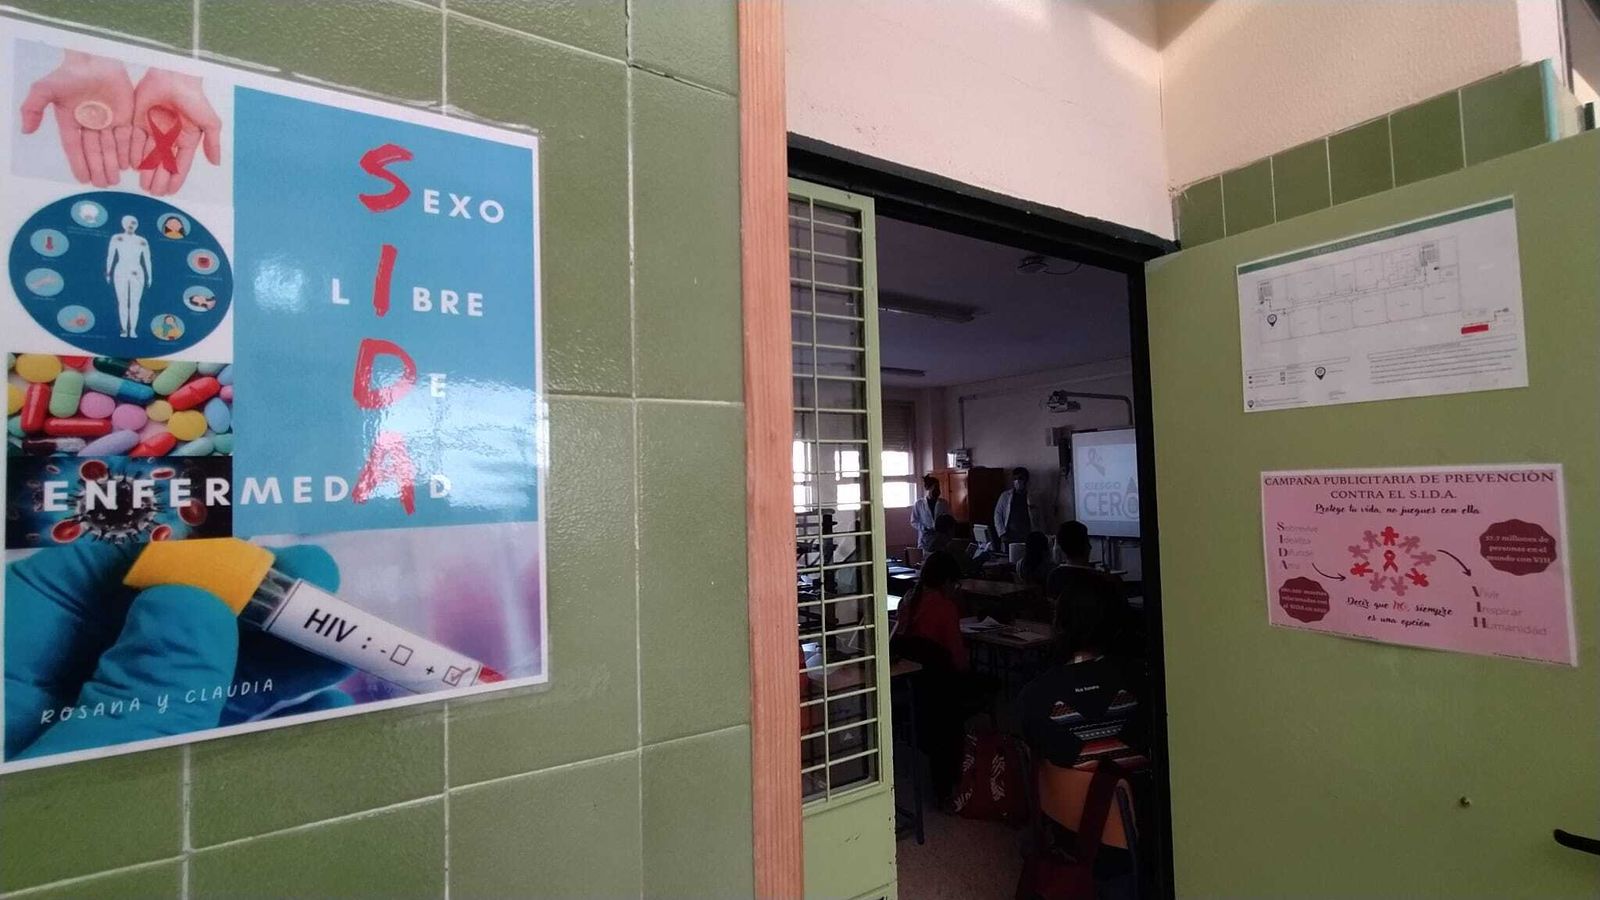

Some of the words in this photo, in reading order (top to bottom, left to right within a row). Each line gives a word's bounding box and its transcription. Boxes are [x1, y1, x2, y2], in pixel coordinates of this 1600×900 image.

[358, 143, 505, 225] SEXO
[331, 244, 484, 318] LIBRE
[353, 337, 447, 410] DE
[43, 431, 452, 516] ENFERMEDAD
[1264, 475, 1320, 486] CAMPAÑA
[1323, 474, 1415, 485] PUBLICITARIA
[1420, 474, 1440, 484] DE
[1445, 470, 1554, 483] PREVENCIÓN
[1330, 490, 1384, 499] CONTRA
[1388, 490, 1406, 499] EL
[1409, 490, 1457, 499] S.I.D.A.
[1314, 503, 1345, 515] Protege
[1373, 602, 1389, 610] que
[1416, 605, 1453, 618] siempre
[40, 697, 141, 725] ROSANA
[186, 678, 274, 705] CLAUDIA
